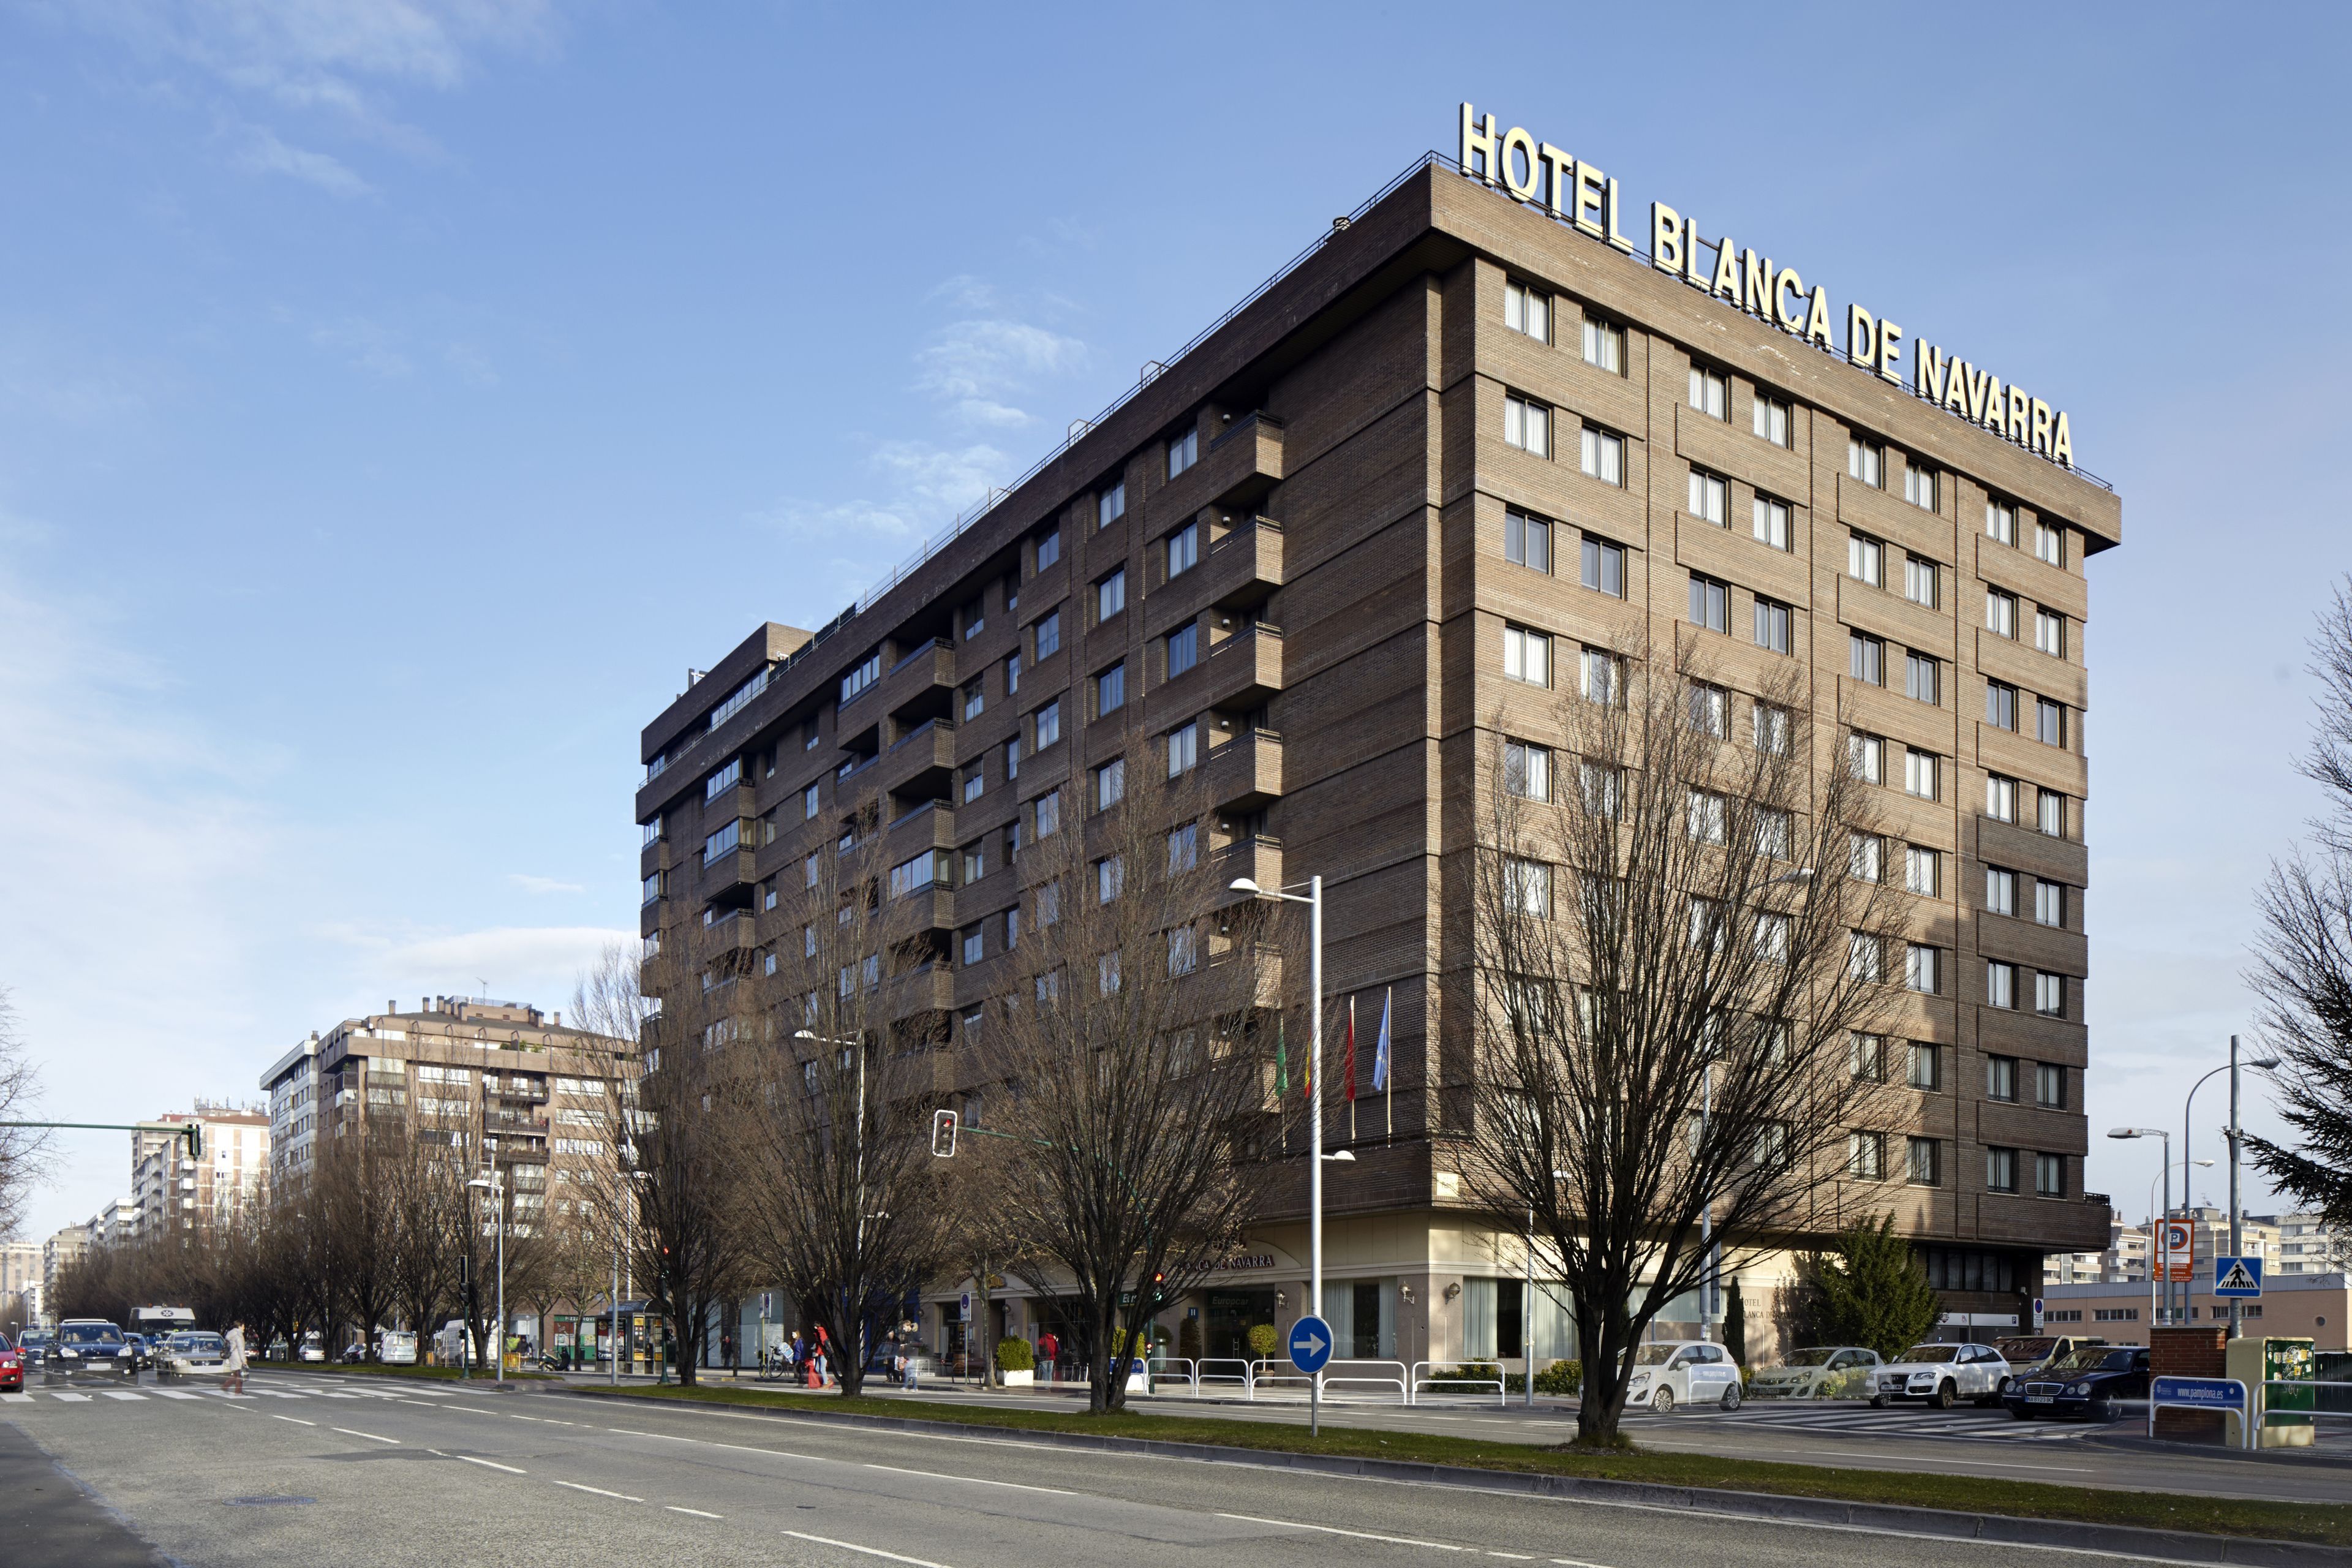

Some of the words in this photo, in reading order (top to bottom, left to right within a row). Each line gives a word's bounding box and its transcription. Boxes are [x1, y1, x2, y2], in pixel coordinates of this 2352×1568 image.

[1459, 102, 1634, 255] HOTEL
[1651, 201, 1834, 353] BLANCA
[1847, 303, 1902, 388] DE
[1915, 337, 2074, 470] NAVARRA
[2171, 1234, 2178, 1242] P
[1231, 1255, 1273, 1268] NAVARRA
[1212, 1296, 1249, 1307] Europcar
[1744, 1298, 1761, 1307] OTEL
[2177, 1387, 2223, 1400] www.pamplona.es
